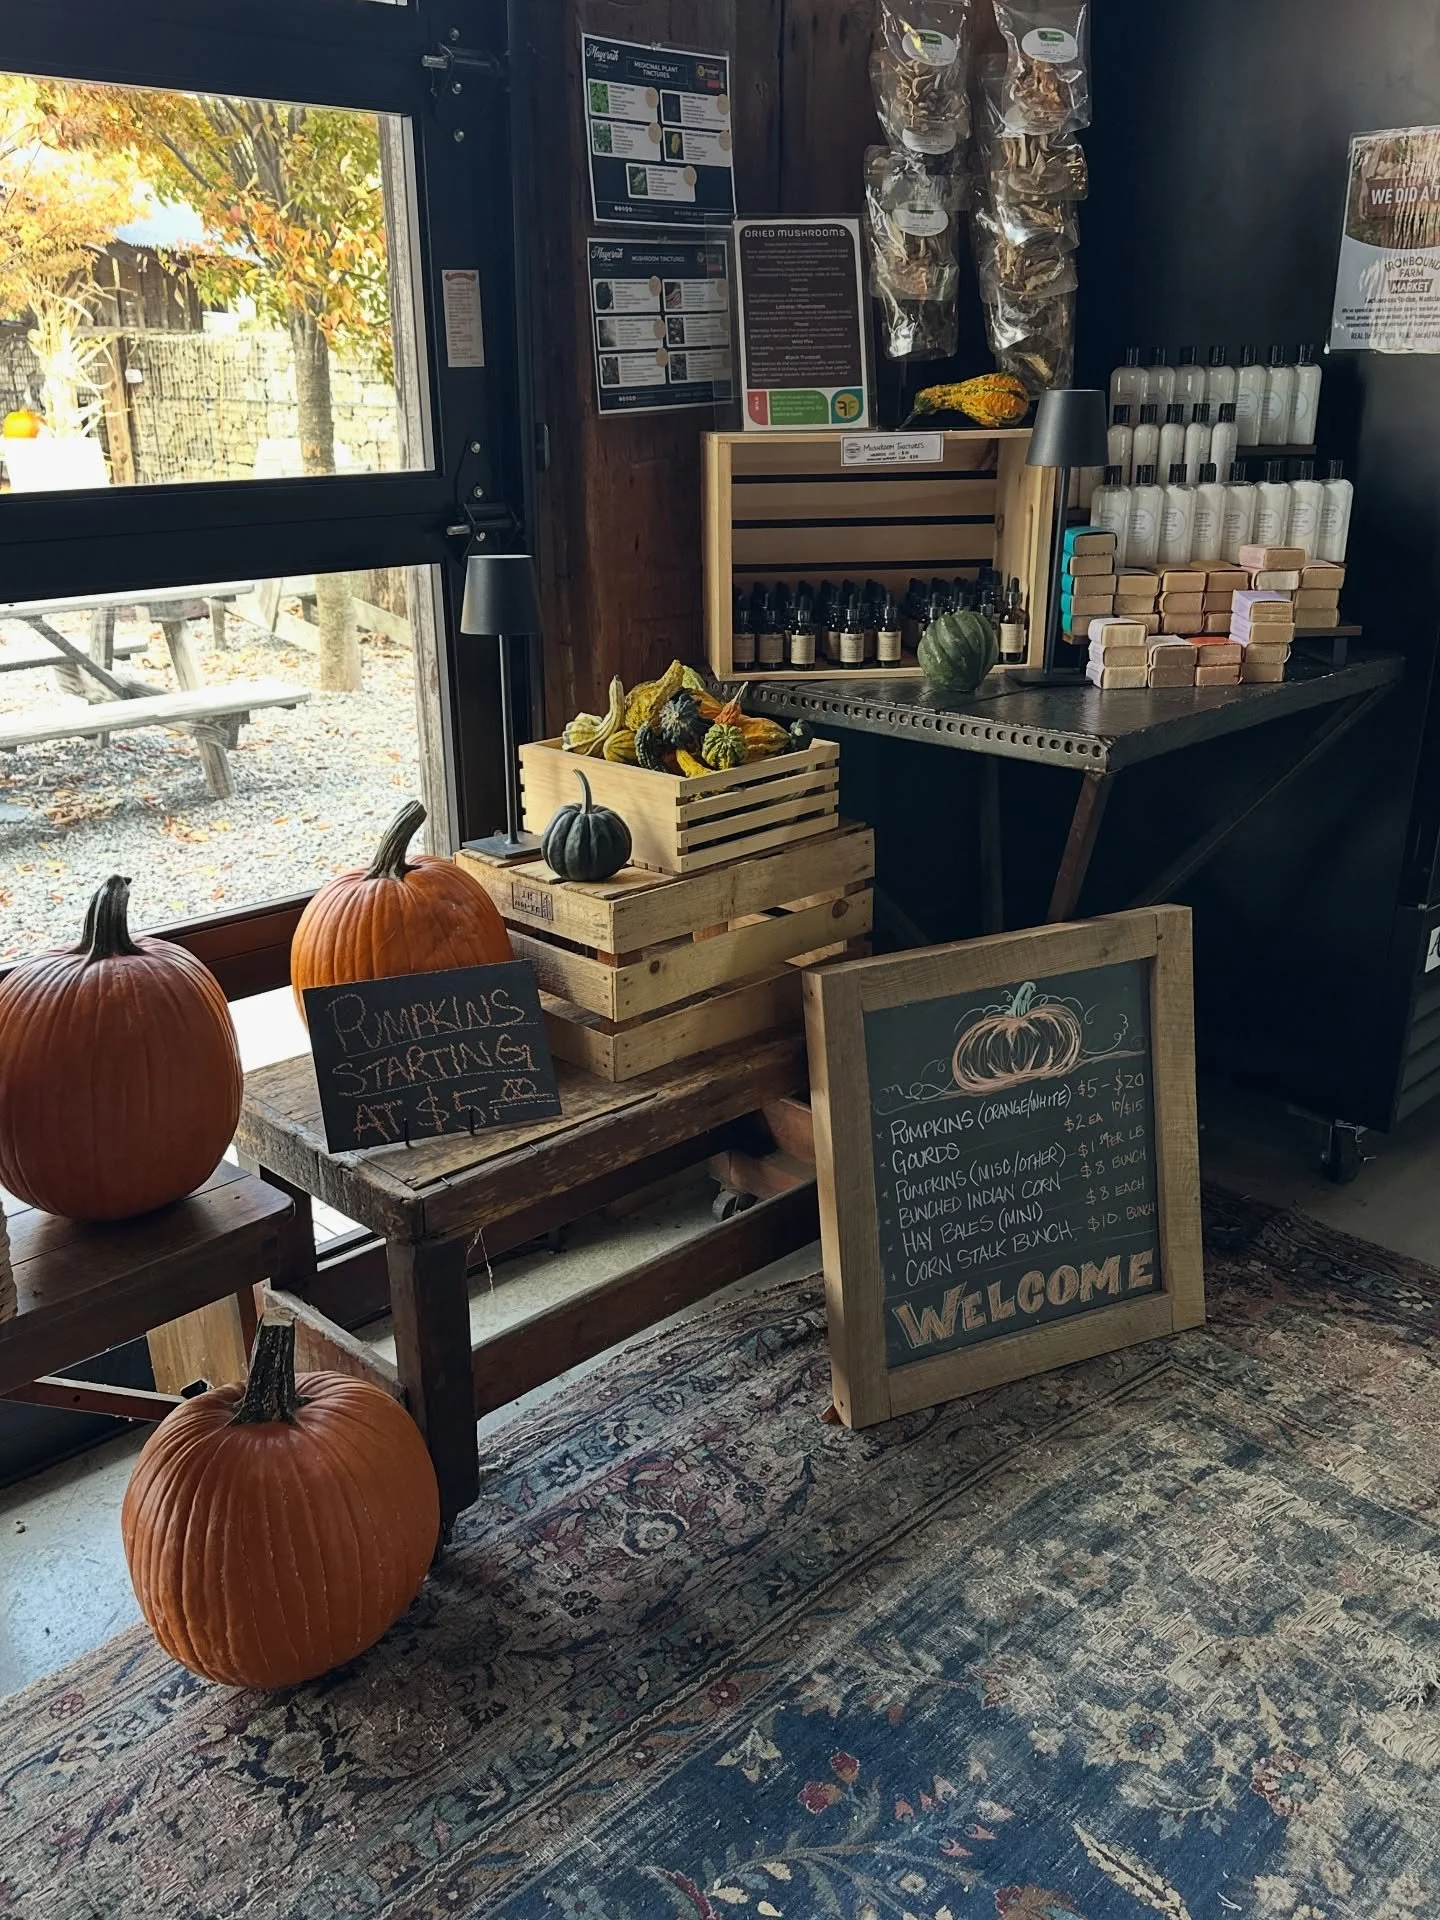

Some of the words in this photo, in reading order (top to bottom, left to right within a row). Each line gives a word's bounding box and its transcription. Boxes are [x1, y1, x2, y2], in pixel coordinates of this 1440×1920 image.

[634, 60, 661, 72] MEDICINAL
[661, 65, 679, 73] PLANT
[643, 69, 671, 79] TINCTURES
[1371, 188, 1393, 205] WE
[1395, 186, 1418, 204] DID
[1420, 185, 1430, 202] A
[744, 229, 775, 238] DRIED
[777, 228, 846, 238] MUSHROOMS
[660, 255, 685, 263] TINCTURES
[1385, 256, 1440, 272] IRONBOUND
[1400, 269, 1424, 277] FARM
[1391, 281, 1429, 293] MARKET
[325, 989, 526, 1053] PUMPKINS
[332, 1034, 536, 1096] STARTING
[353, 1099, 403, 1142] AT
[890, 1110, 975, 1146] PUMPKINS
[892, 1143, 960, 1176] GOURDS
[896, 1170, 967, 1204] PUMPKINS
[899, 1197, 962, 1229] BUNCHED
[967, 1184, 1015, 1211] INDIAN
[1021, 1171, 1061, 1199] CORN
[1112, 1146, 1147, 1169] BUNCH
[902, 1227, 933, 1257] HAY
[940, 1215, 994, 1244] BALES
[998, 1201, 1043, 1234] (MINI)
[1115, 1175, 1145, 1196] EACH
[906, 1253, 953, 1287] CORN
[956, 1238, 1008, 1270] STALK
[1011, 1220, 1073, 1253] BUNCH
[892, 1249, 1154, 1348] WELCOME
